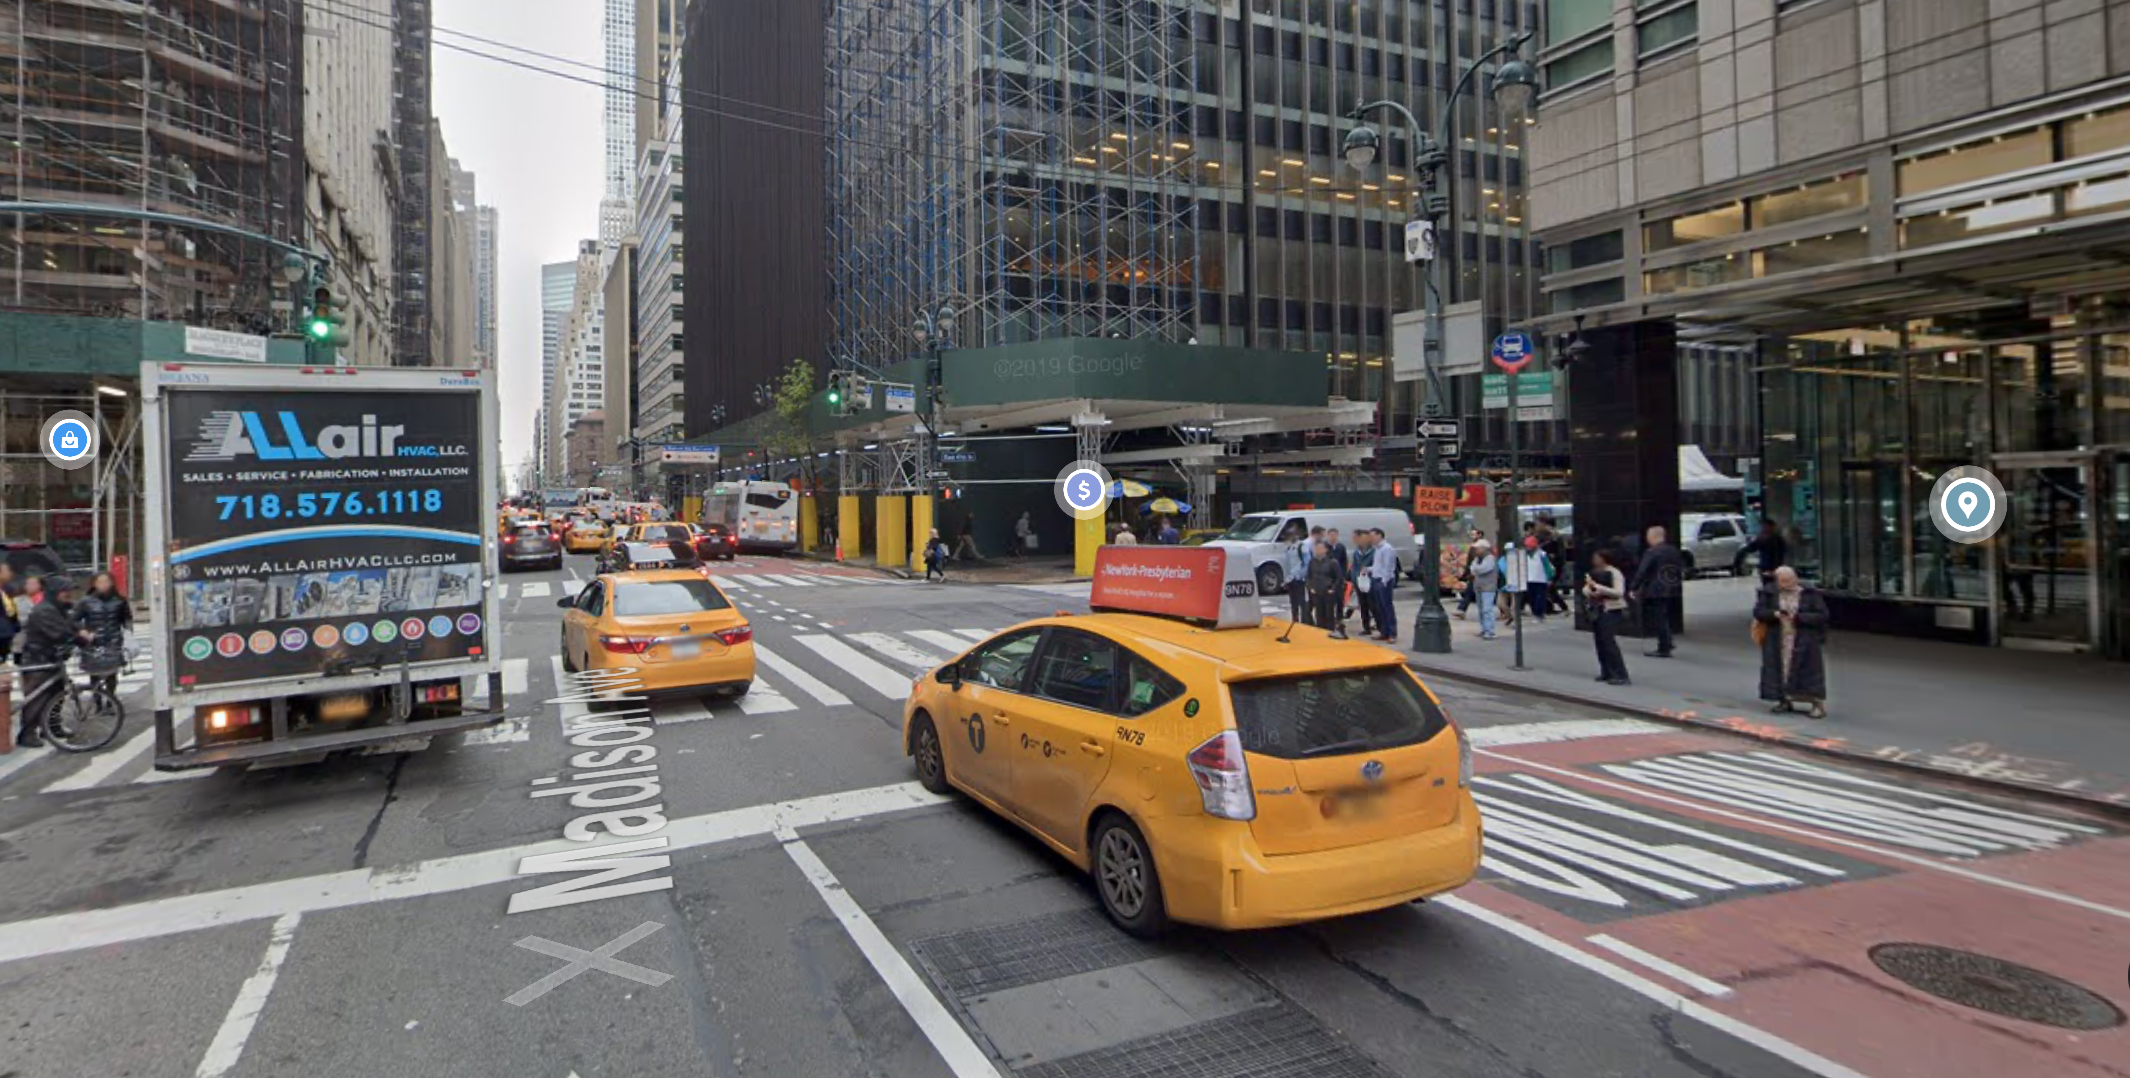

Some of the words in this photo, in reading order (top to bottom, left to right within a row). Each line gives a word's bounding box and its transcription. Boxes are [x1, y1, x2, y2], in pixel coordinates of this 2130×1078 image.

[183, 473, 223, 482] SALES
[236, 471, 287, 481] SERVICE
[300, 469, 379, 480] FABRICATION
[389, 467, 468, 477] INSTALLATION
[1419, 489, 1451, 501] RAISE
[215, 489, 442, 520] 718.576.1118
[1419, 501, 1450, 513] PLOW
[1225, 583, 1253, 597] 9N78
[1117, 726, 1146, 746] 9N78
